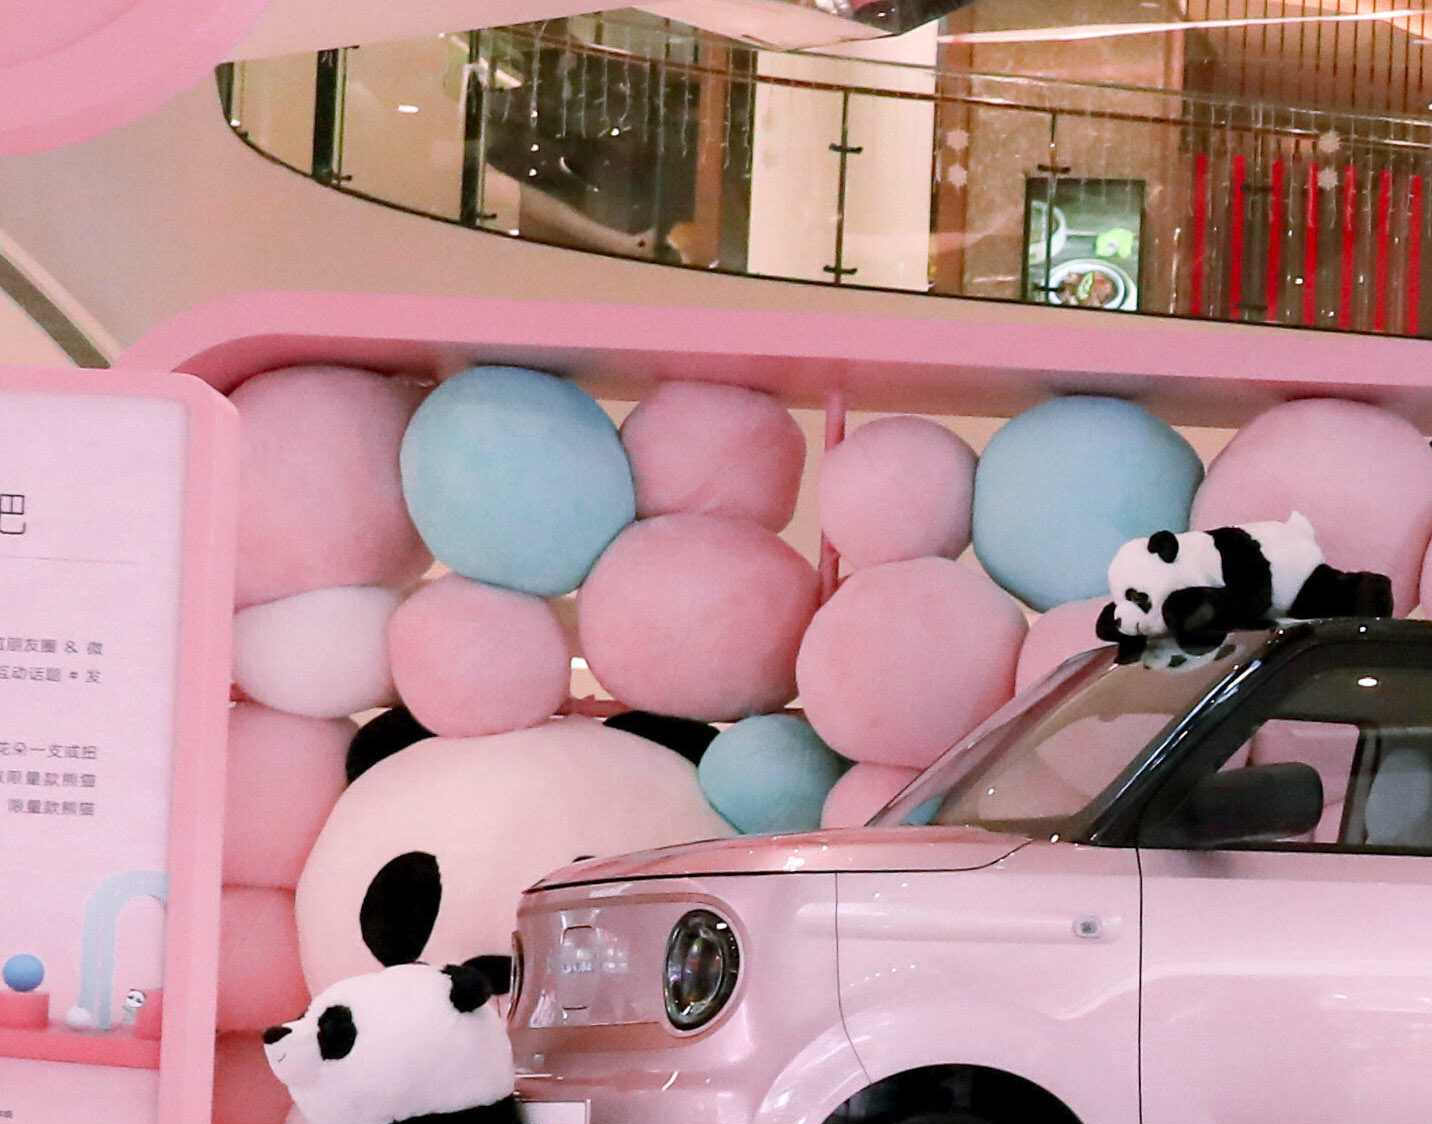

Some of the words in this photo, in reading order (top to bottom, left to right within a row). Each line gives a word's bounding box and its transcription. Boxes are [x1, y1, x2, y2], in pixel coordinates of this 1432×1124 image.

[0, 770, 96, 788] 限量款熊猫
